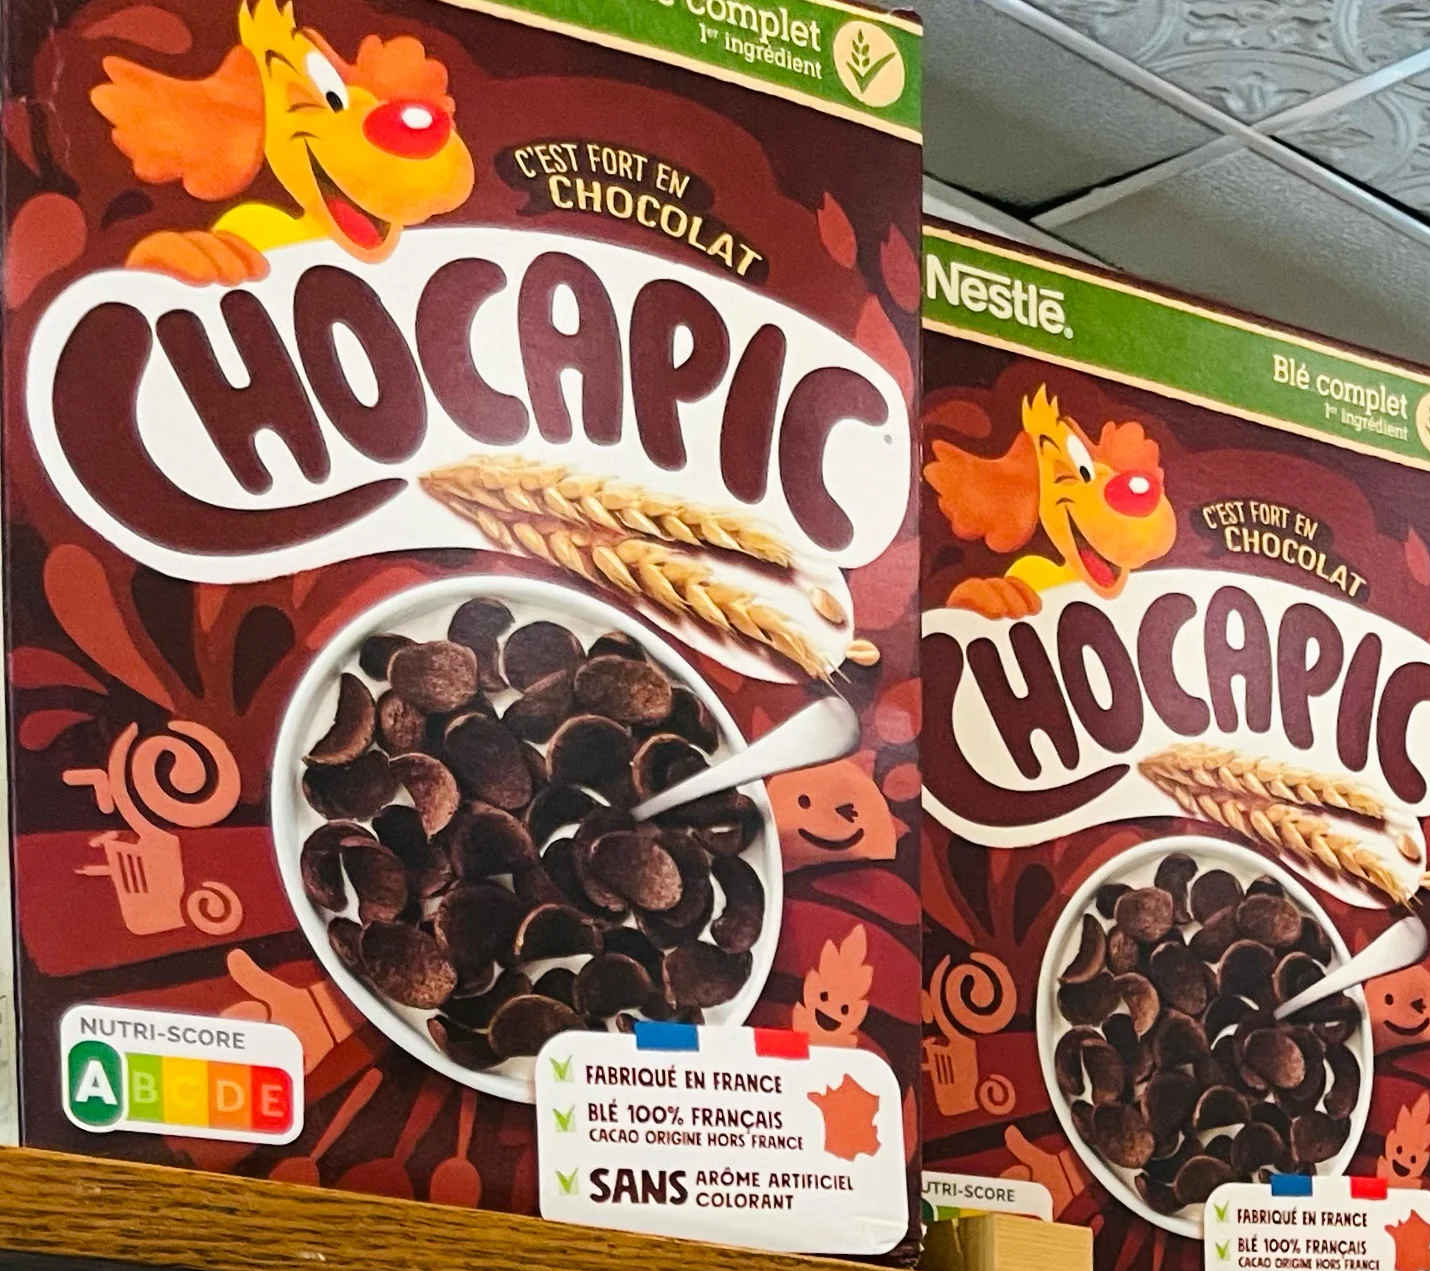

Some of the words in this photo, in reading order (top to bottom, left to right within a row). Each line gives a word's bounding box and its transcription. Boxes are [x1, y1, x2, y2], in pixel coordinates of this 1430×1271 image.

[724, 31, 823, 80] ingrédient
[515, 144, 579, 180] C'EST
[588, 143, 649, 185] FORT
[656, 161, 691, 200] EN
[550, 174, 764, 279] CHOCOLAT
[51, 251, 890, 558] CHOCAPIC
[1272, 353, 1311, 391] Blé
[1316, 373, 1410, 421] complet
[1202, 502, 1247, 531] C'EST
[1250, 502, 1289, 527] FORT
[1295, 514, 1319, 540] EN
[1224, 528, 1368, 598] CHOCOLAT
[79, 1014, 246, 1051] NUTRI-SCORE
[586, 1059, 677, 1091] FABRIQUÉ
[682, 1070, 707, 1094] EN
[712, 1071, 784, 1096] FRANCE
[587, 1099, 619, 1124] BLÉ
[626, 1102, 685, 1128] 100%
[691, 1104, 784, 1137] FRANÇAIS
[588, 1126, 641, 1147] CACAO
[643, 1128, 702, 1149] ORIGINE
[705, 1130, 746, 1150] HORS
[750, 1133, 804, 1152] FRANCE
[589, 1168, 690, 1206] SANS
[695, 1167, 762, 1190] ARÔME
[767, 1172, 855, 1194] ARTIFICIEL
[695, 1191, 795, 1212] COLORANT
[1236, 1205, 1298, 1226] FABRIQUÉ
[1302, 1210, 1319, 1225] EN
[1320, 1210, 1368, 1228] FRANCE
[1237, 1234, 1258, 1255] BLÉ
[1263, 1237, 1301, 1256] 100%
[1305, 1237, 1368, 1260] FRANÇAIS
